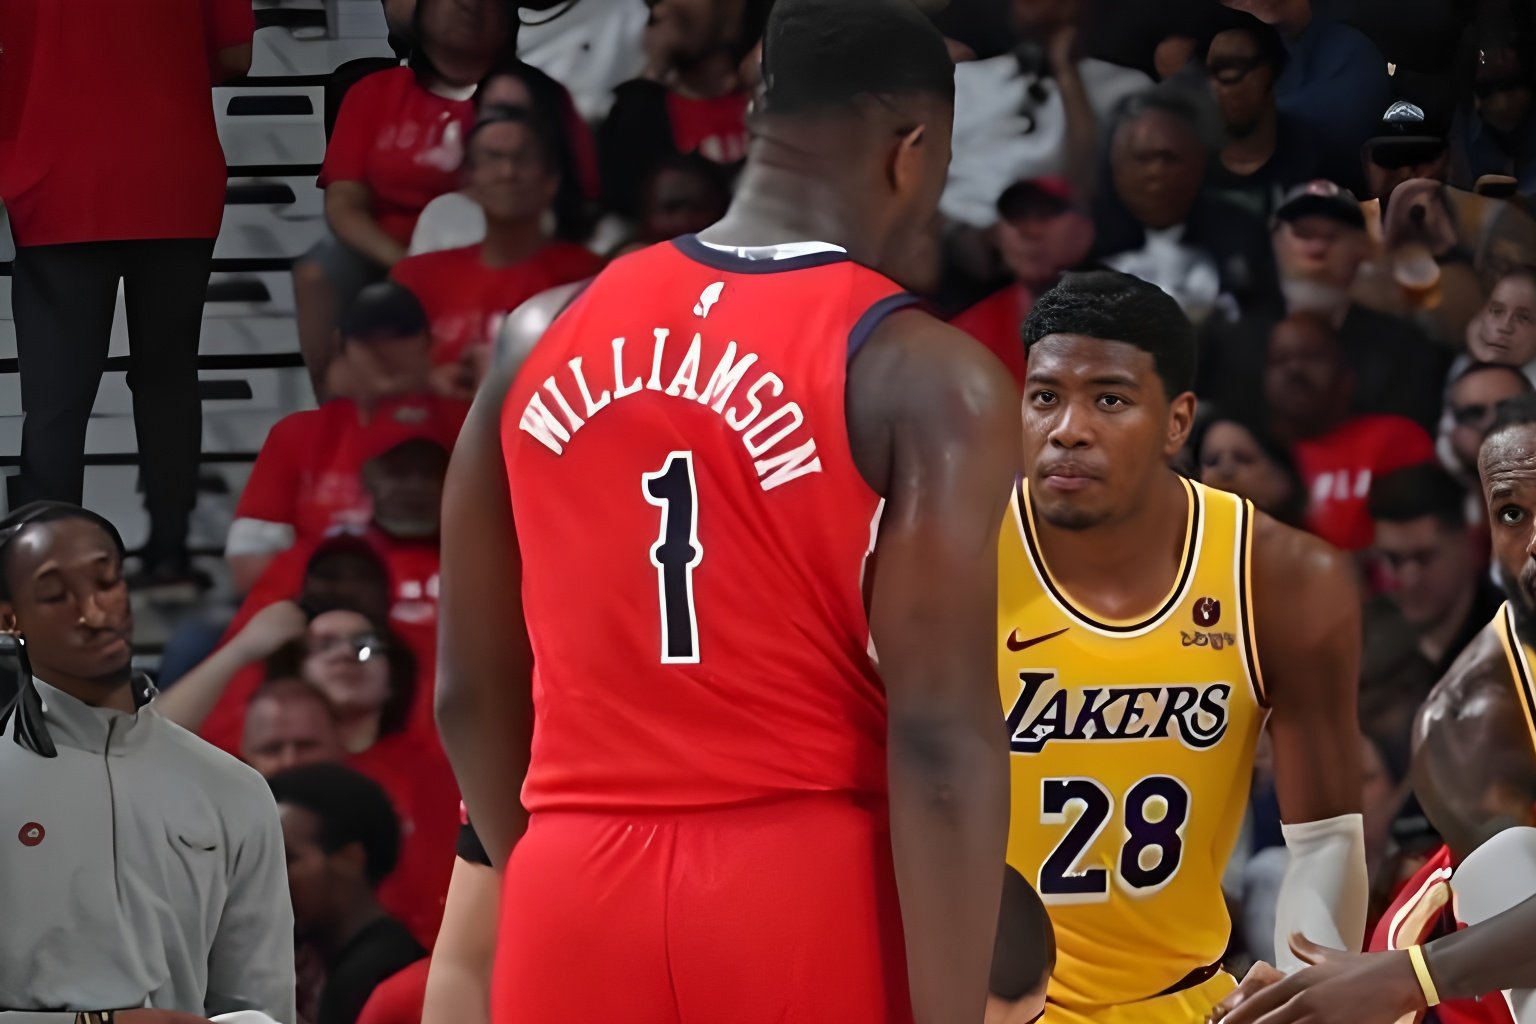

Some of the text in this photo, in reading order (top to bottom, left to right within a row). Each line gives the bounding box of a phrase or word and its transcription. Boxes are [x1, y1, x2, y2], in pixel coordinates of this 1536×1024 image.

[519, 327, 823, 491] WILLIAMSON
[641, 450, 704, 664] 1
[1004, 669, 1233, 755] LAKERS
[1037, 773, 1193, 904] 28
